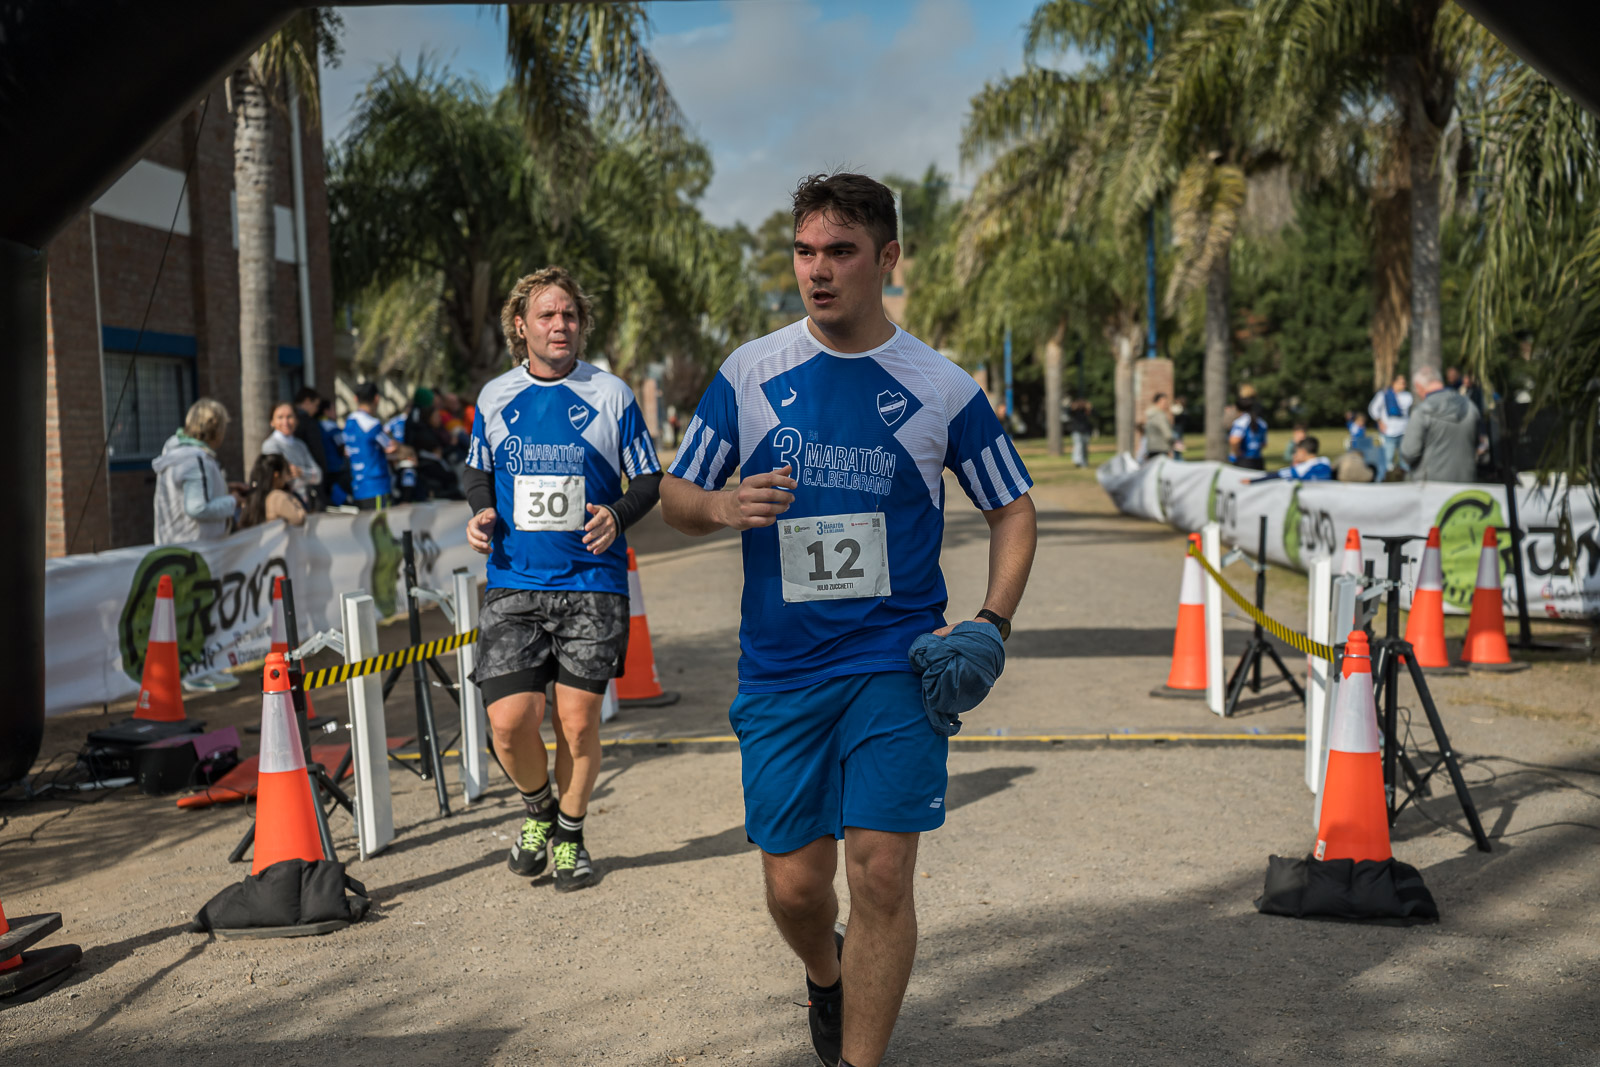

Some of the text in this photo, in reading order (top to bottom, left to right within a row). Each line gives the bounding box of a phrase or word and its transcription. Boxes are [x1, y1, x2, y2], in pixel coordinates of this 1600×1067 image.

[504, 435, 585, 476] 3 MARATÓN
[804, 442, 896, 477] MARATÓN
[528, 492, 568, 518] 30
[816, 521, 824, 536] 3
[806, 538, 865, 581] 12
[816, 582, 854, 592] JULIO ZUCCHETTI
